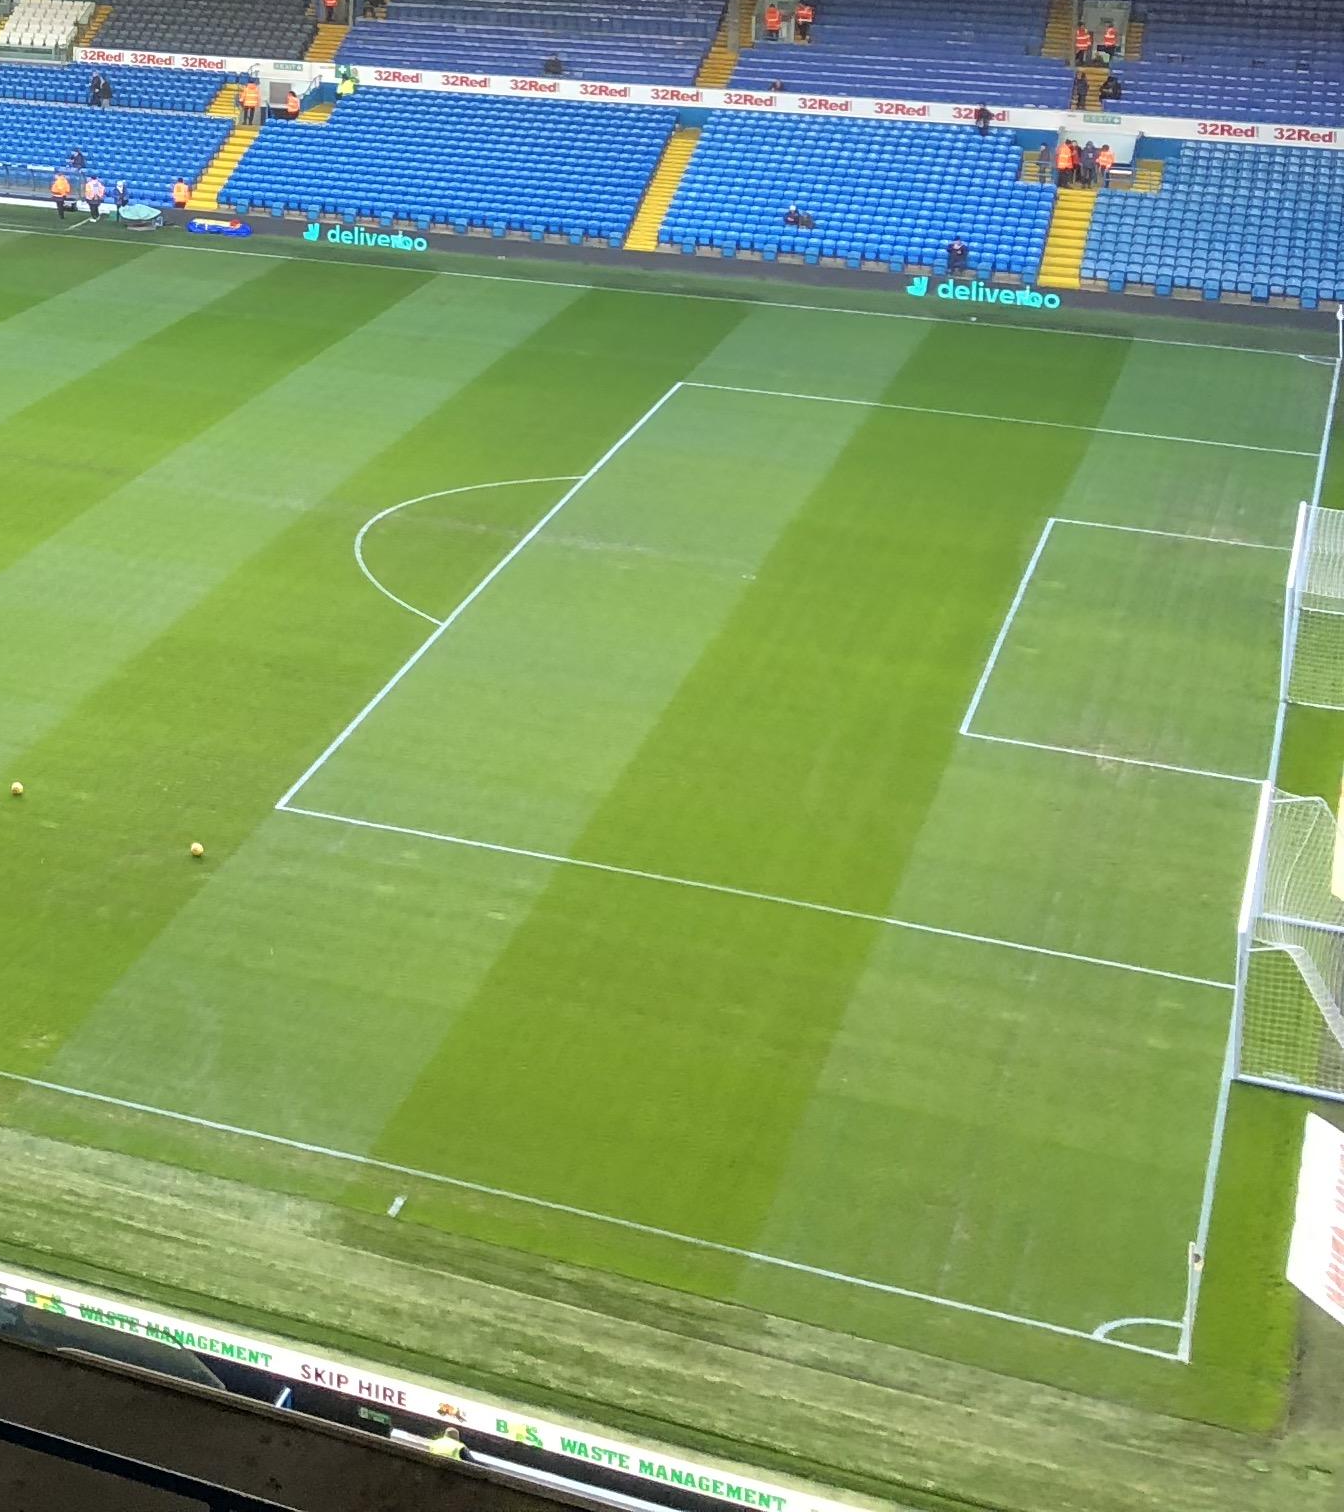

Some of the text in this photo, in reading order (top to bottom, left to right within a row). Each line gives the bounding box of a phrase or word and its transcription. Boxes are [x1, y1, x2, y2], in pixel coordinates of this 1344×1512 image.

[80, 49, 122, 63] 32Red
[130, 52, 173, 66] 32Red
[181, 56, 224, 70] 32Red
[374, 70, 419, 84] 32Red
[441, 74, 488, 88] 32Red
[510, 79, 557, 93] 32Red
[579, 84, 629, 98] 32Red
[651, 88, 700, 103] 32Red
[723, 93, 775, 107] 32Red
[798, 97, 850, 112] 32Red
[874, 102, 926, 117] 32Red
[1197, 123, 1256, 138] 32Red
[1274, 127, 1334, 143] 32Red
[79, 1303, 140, 1332] WASTE
[146, 1321, 273, 1368] MANAGEMENT
[300, 1364, 407, 1407] SKIP HIRE
[560, 1436, 631, 1470] WASTE
[638, 1458, 787, 1511] MANAGEMENT
